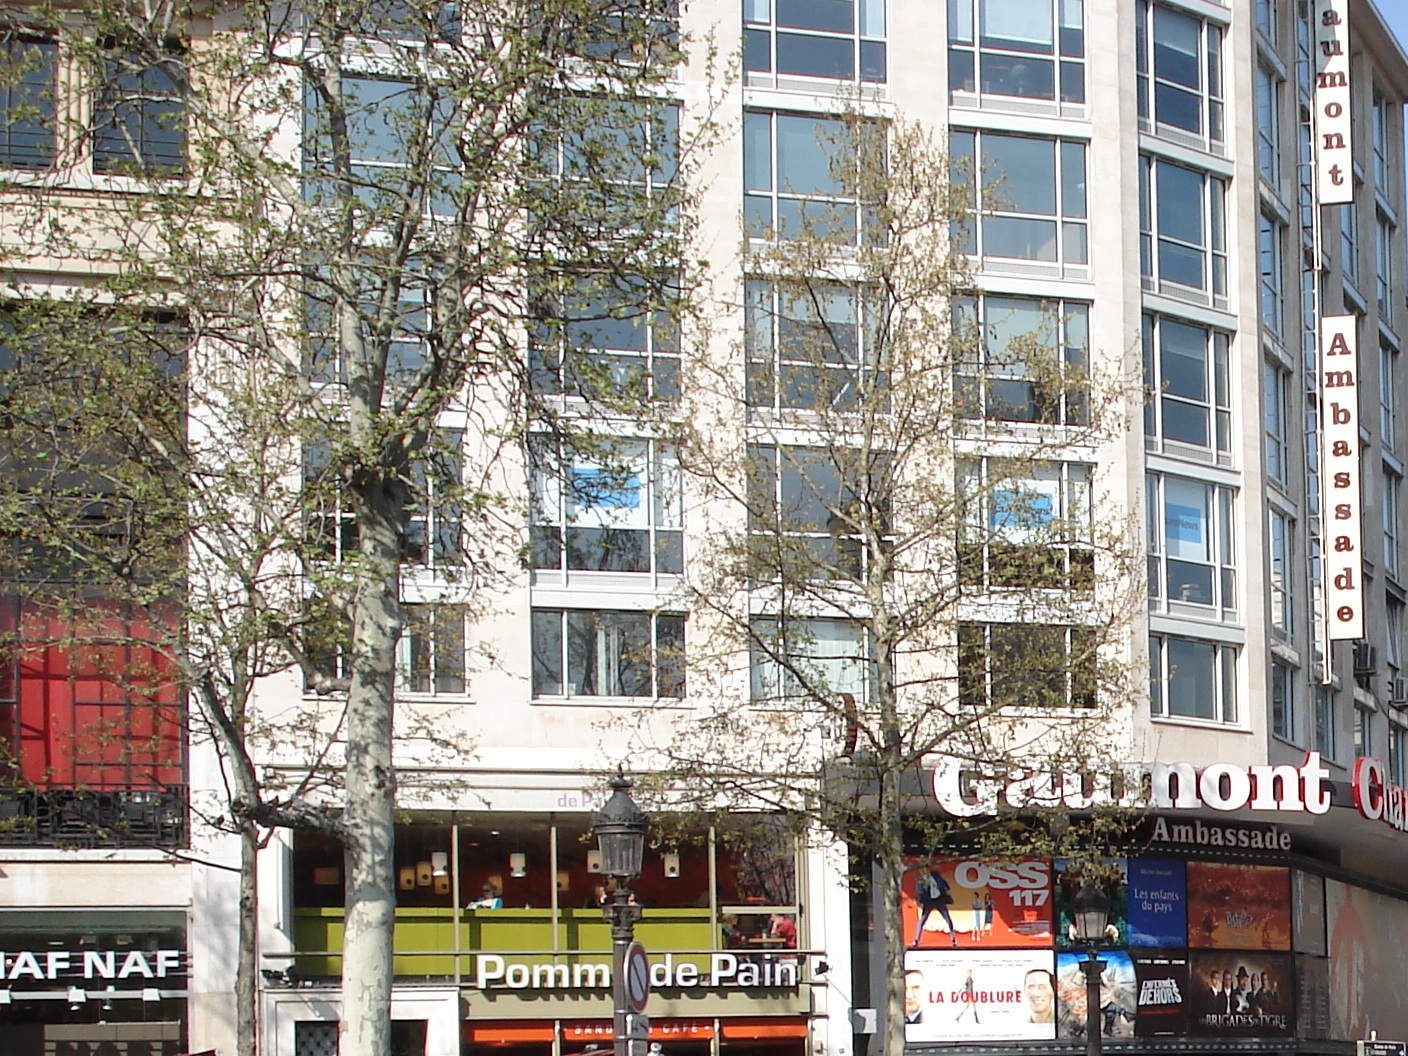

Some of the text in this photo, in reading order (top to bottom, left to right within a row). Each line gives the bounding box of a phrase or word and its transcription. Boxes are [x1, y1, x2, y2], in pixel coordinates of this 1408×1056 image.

[1318, 8, 1348, 187] aumont
[1325, 332, 1355, 623] Ambassade
[931, 750, 1332, 818] Gaumont
[1153, 816, 1293, 851] Ambassade
[954, 861, 1050, 889] OSS
[1008, 889, 1050, 906] 117
[1134, 888, 1180, 901] Les enfants
[1154, 903, 1173, 914] pays
[0, 950, 180, 980] AF NAF
[476, 953, 797, 989] Pomm de Pain
[929, 990, 1022, 1004] LA DOUBLURE
[1138, 988, 1182, 1006] DEHORS
[1206, 1014, 1254, 1028] BRIGADES
